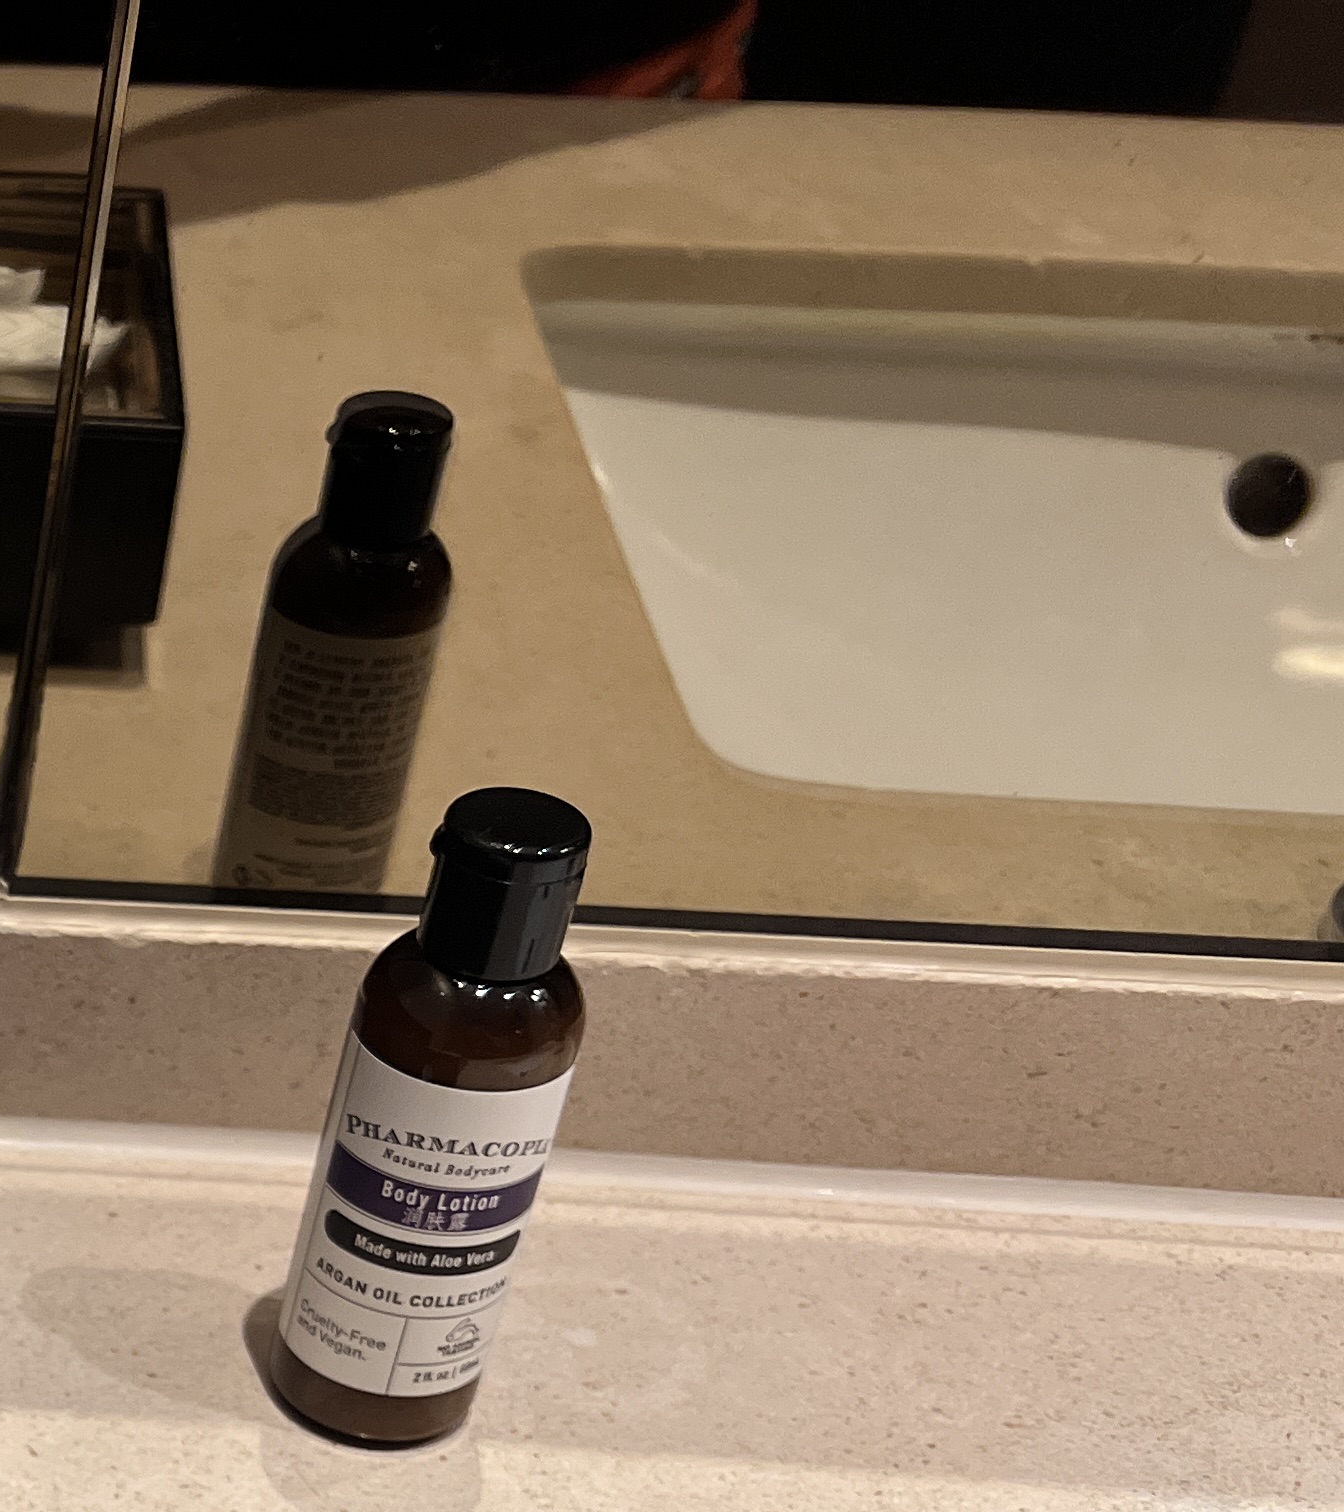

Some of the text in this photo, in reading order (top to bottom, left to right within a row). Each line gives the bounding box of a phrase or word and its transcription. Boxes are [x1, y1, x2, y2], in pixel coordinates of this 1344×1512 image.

[382, 1147, 511, 1181] Natural Bodycare
[380, 1179, 501, 1212] Body Lotion
[353, 1233, 496, 1269] Made with Aloe Vera
[316, 1256, 507, 1308] ARGAN OIL COLLECTION
[299, 1297, 387, 1352] Cruelty-Free
